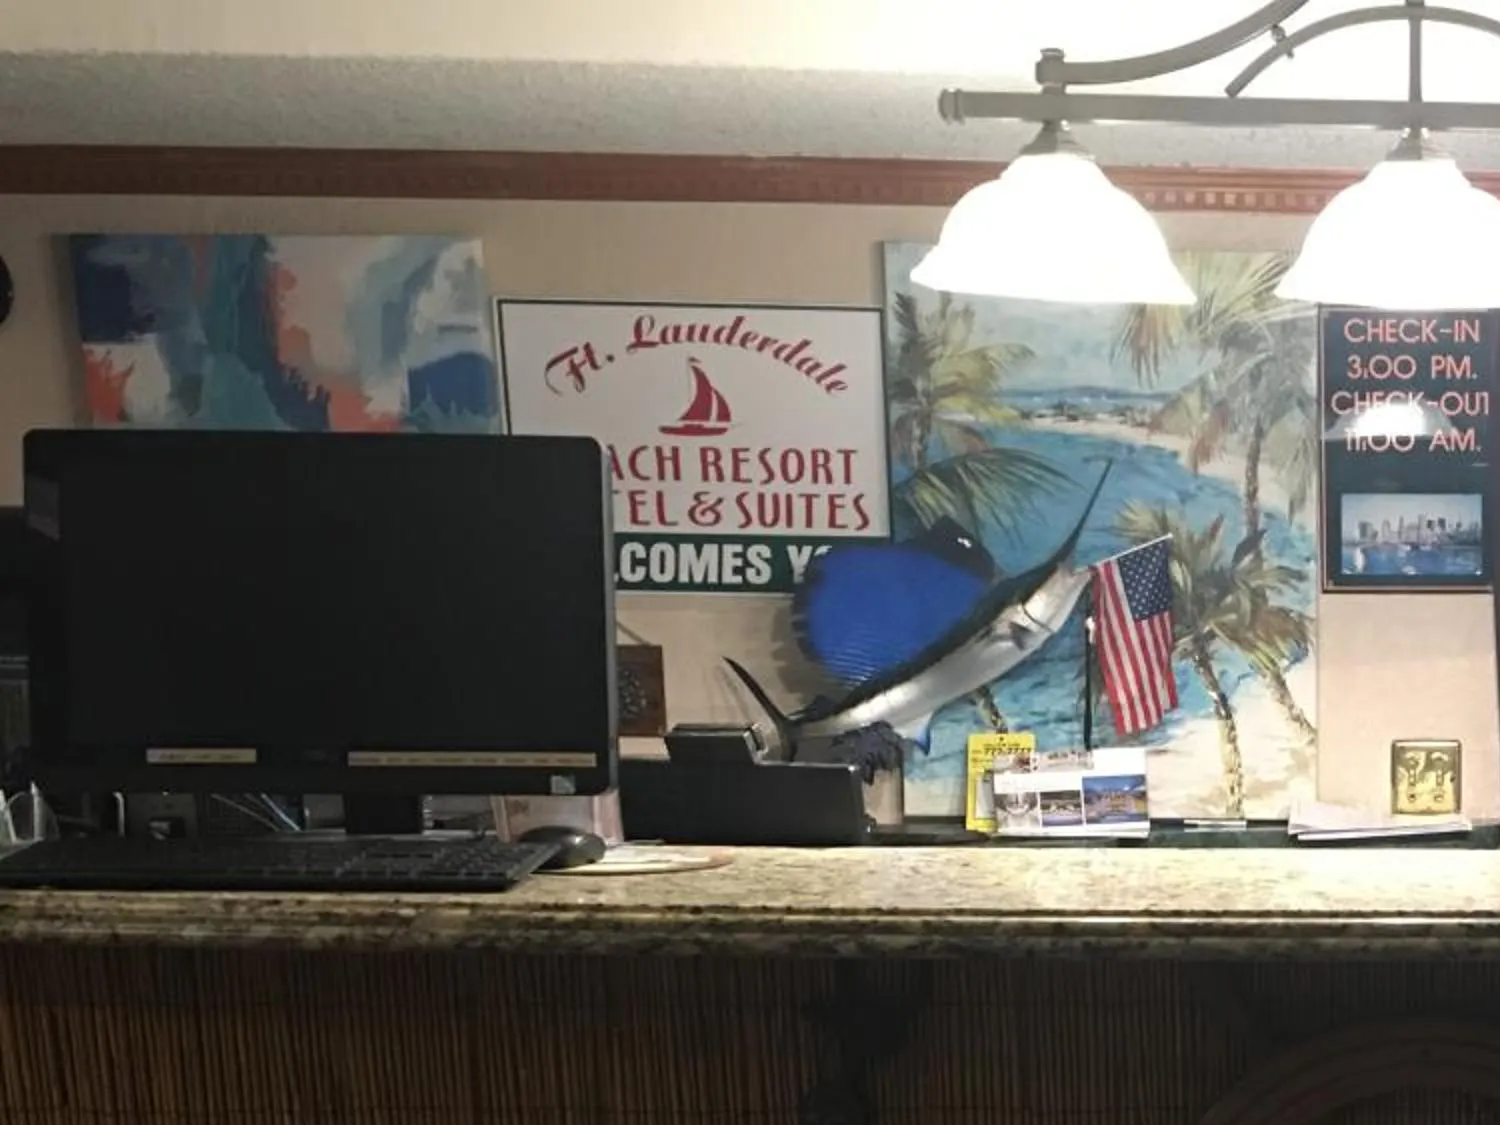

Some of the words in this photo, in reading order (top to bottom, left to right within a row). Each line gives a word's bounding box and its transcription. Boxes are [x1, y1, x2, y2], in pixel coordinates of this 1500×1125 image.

[1343, 319, 1481, 343] CHECK-IN
[544, 342, 615, 396] Ft.
[626, 314, 849, 397] Lauderdale
[699, 446, 858, 485] RESORT
[613, 490, 679, 527] EL
[687, 491, 724, 527] &
[736, 491, 871, 531] SUITES
[613, 542, 772, 585] COMES
